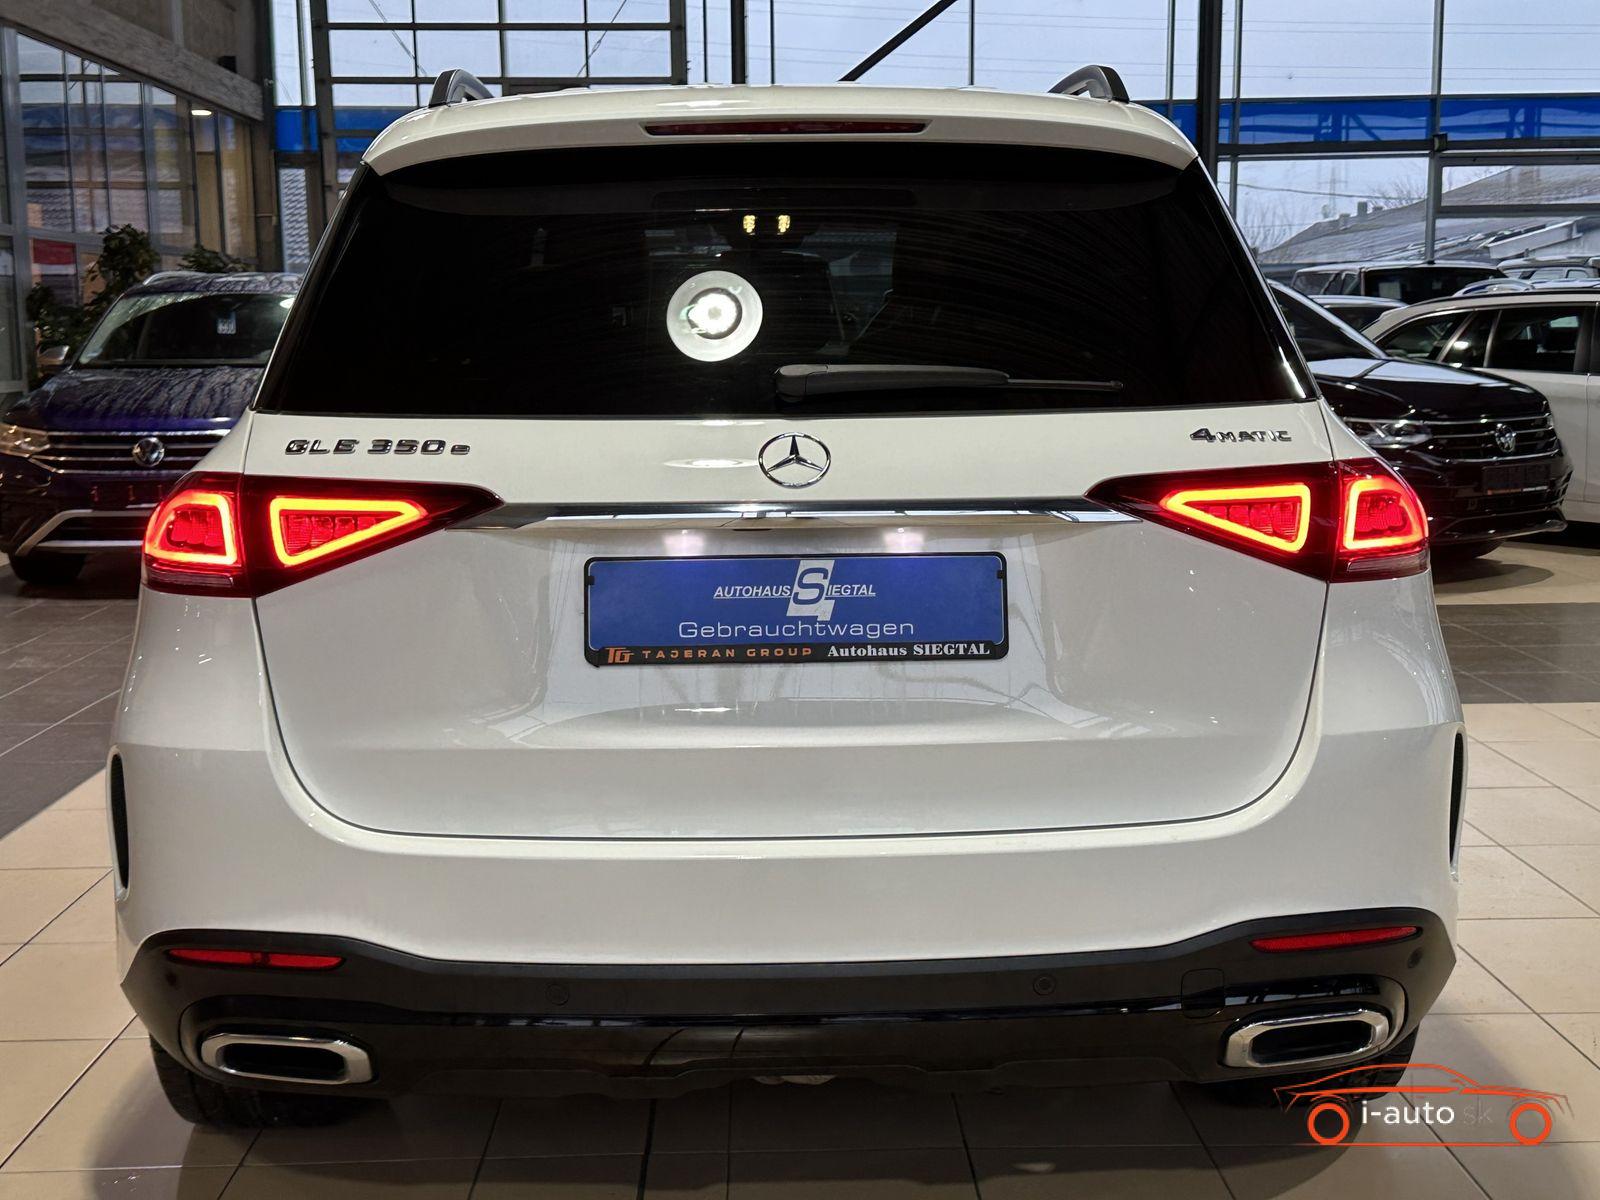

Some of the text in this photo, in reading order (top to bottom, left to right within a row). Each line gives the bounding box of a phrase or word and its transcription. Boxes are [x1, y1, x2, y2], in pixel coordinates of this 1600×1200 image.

[1189, 427, 1293, 442] 4MATIC
[285, 439, 360, 455] GLE
[713, 585, 791, 599] AUTOHAUS
[678, 620, 914, 639] Gebrauchtwagen
[642, 648, 735, 659] TAJERAN
[746, 647, 812, 657] GROUP
[827, 644, 908, 657] Autohaus
[913, 643, 990, 656] SIEGTAL
